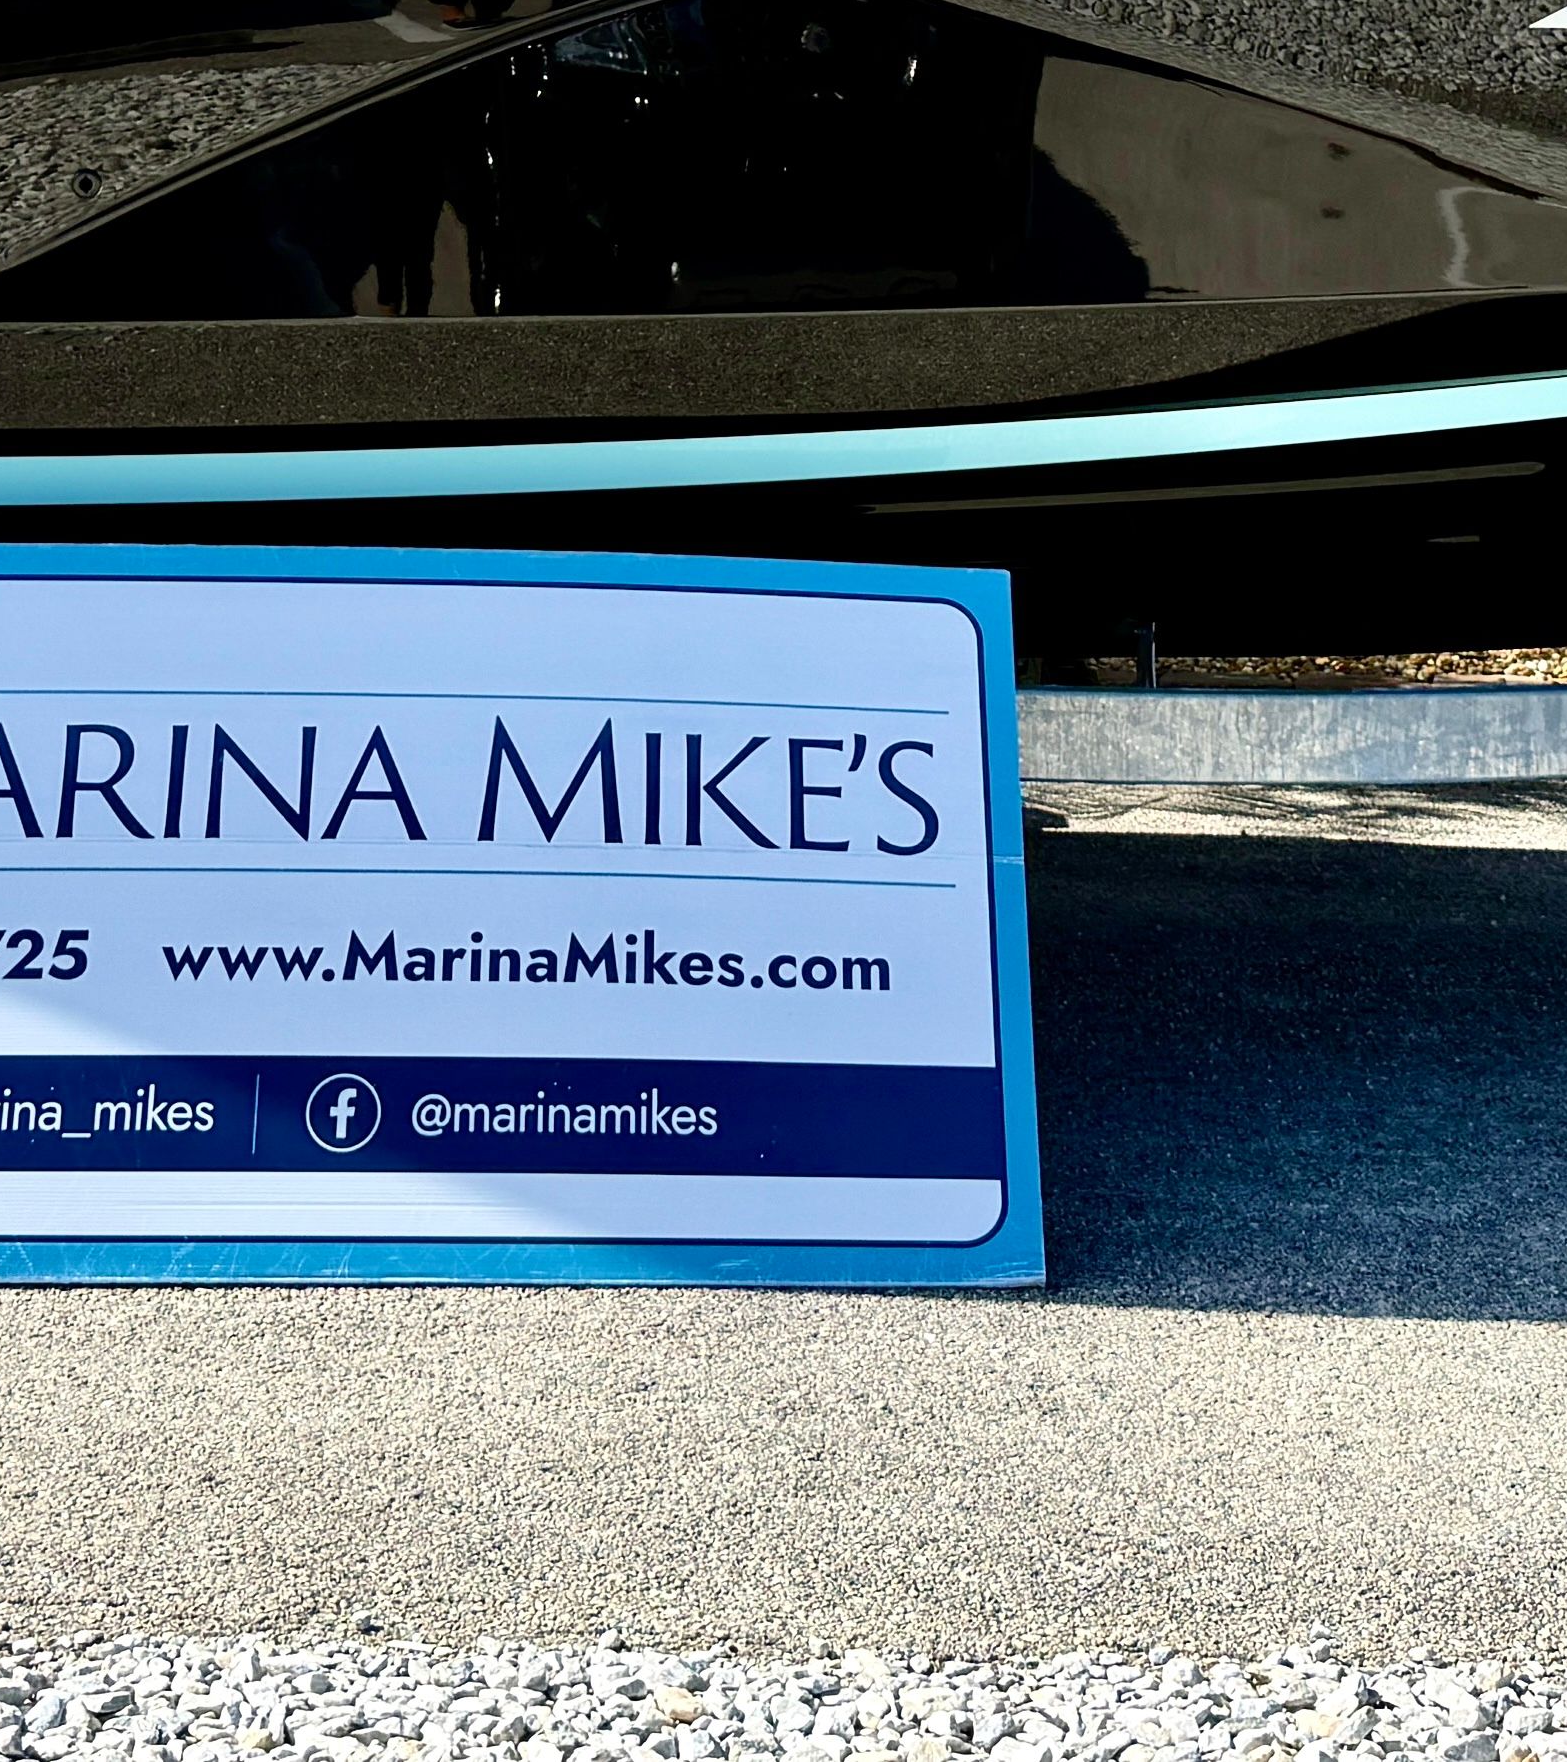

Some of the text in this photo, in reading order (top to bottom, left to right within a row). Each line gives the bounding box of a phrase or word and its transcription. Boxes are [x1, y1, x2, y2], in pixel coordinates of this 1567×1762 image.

[477, 715, 939, 856] MIKE'S
[161, 930, 891, 991] www.MarinaMikes.com
[411, 1087, 718, 1137] @marinamikes
